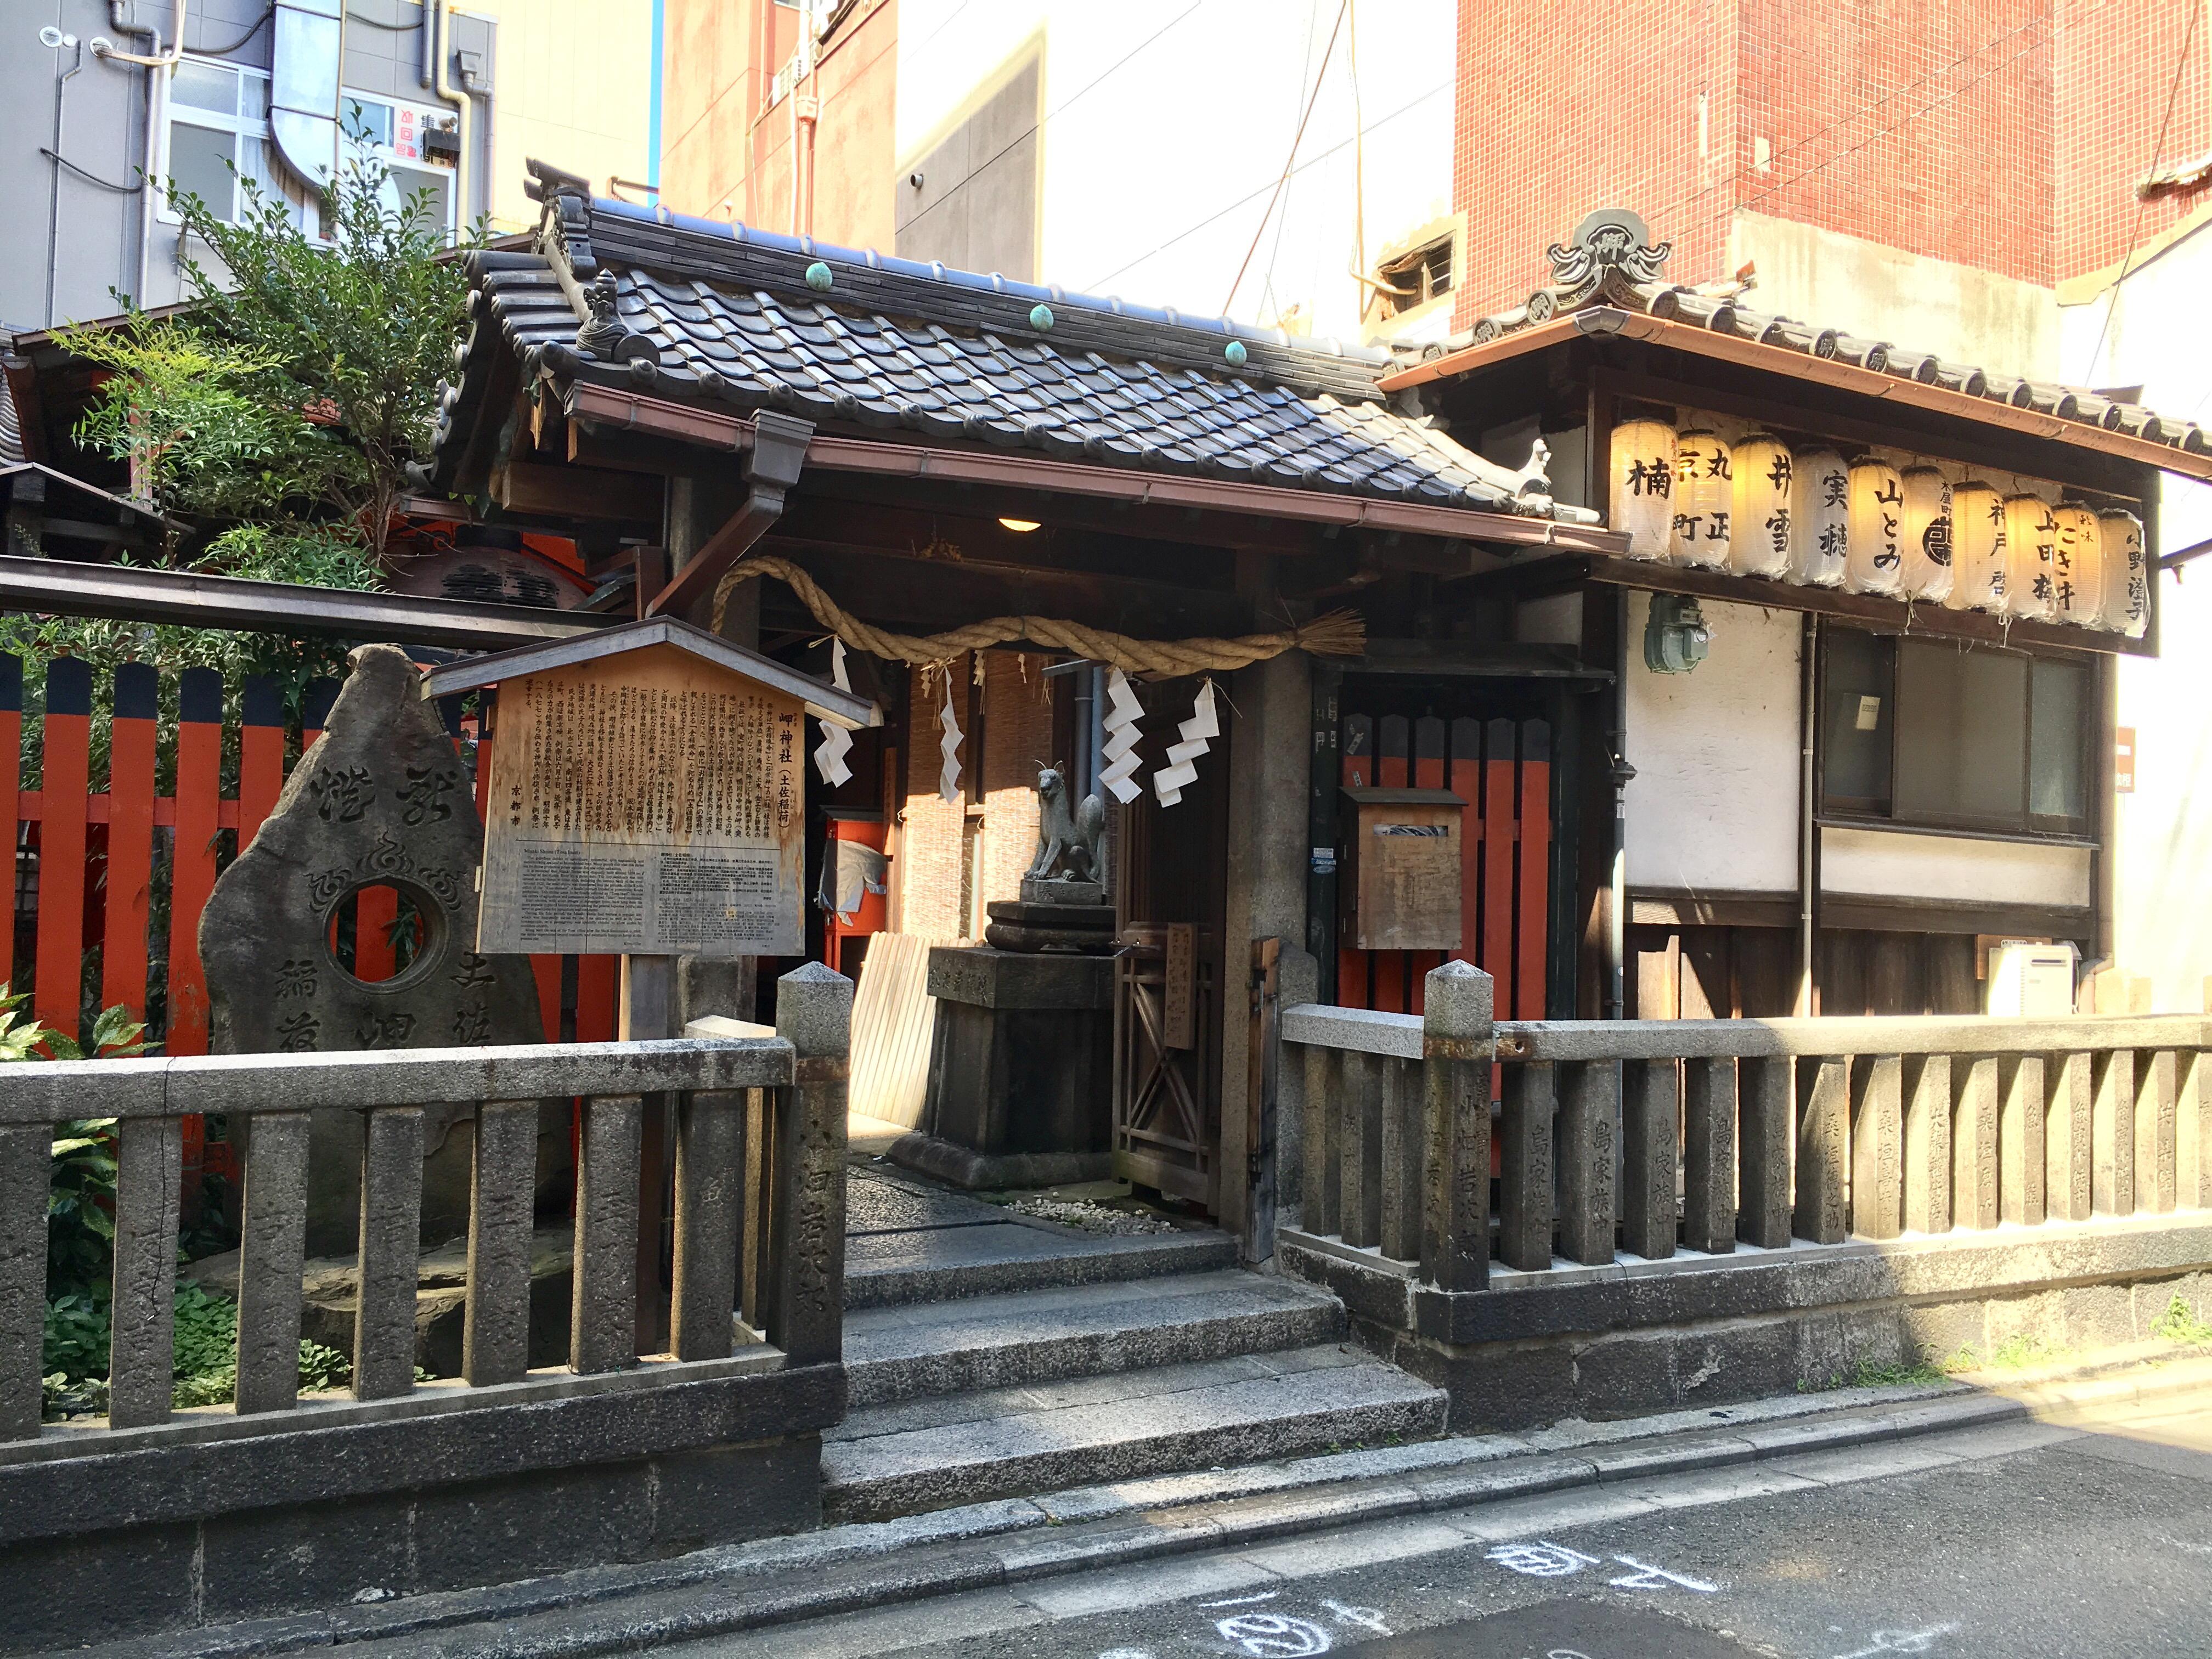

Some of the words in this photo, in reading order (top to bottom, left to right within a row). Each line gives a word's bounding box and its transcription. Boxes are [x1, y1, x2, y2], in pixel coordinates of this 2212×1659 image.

[1625, 457, 1671, 500] 楠
[1939, 481, 1952, 517] 木屋町
[1874, 478, 1904, 571] 山とみ
[510, 785, 522, 826] 京都市
